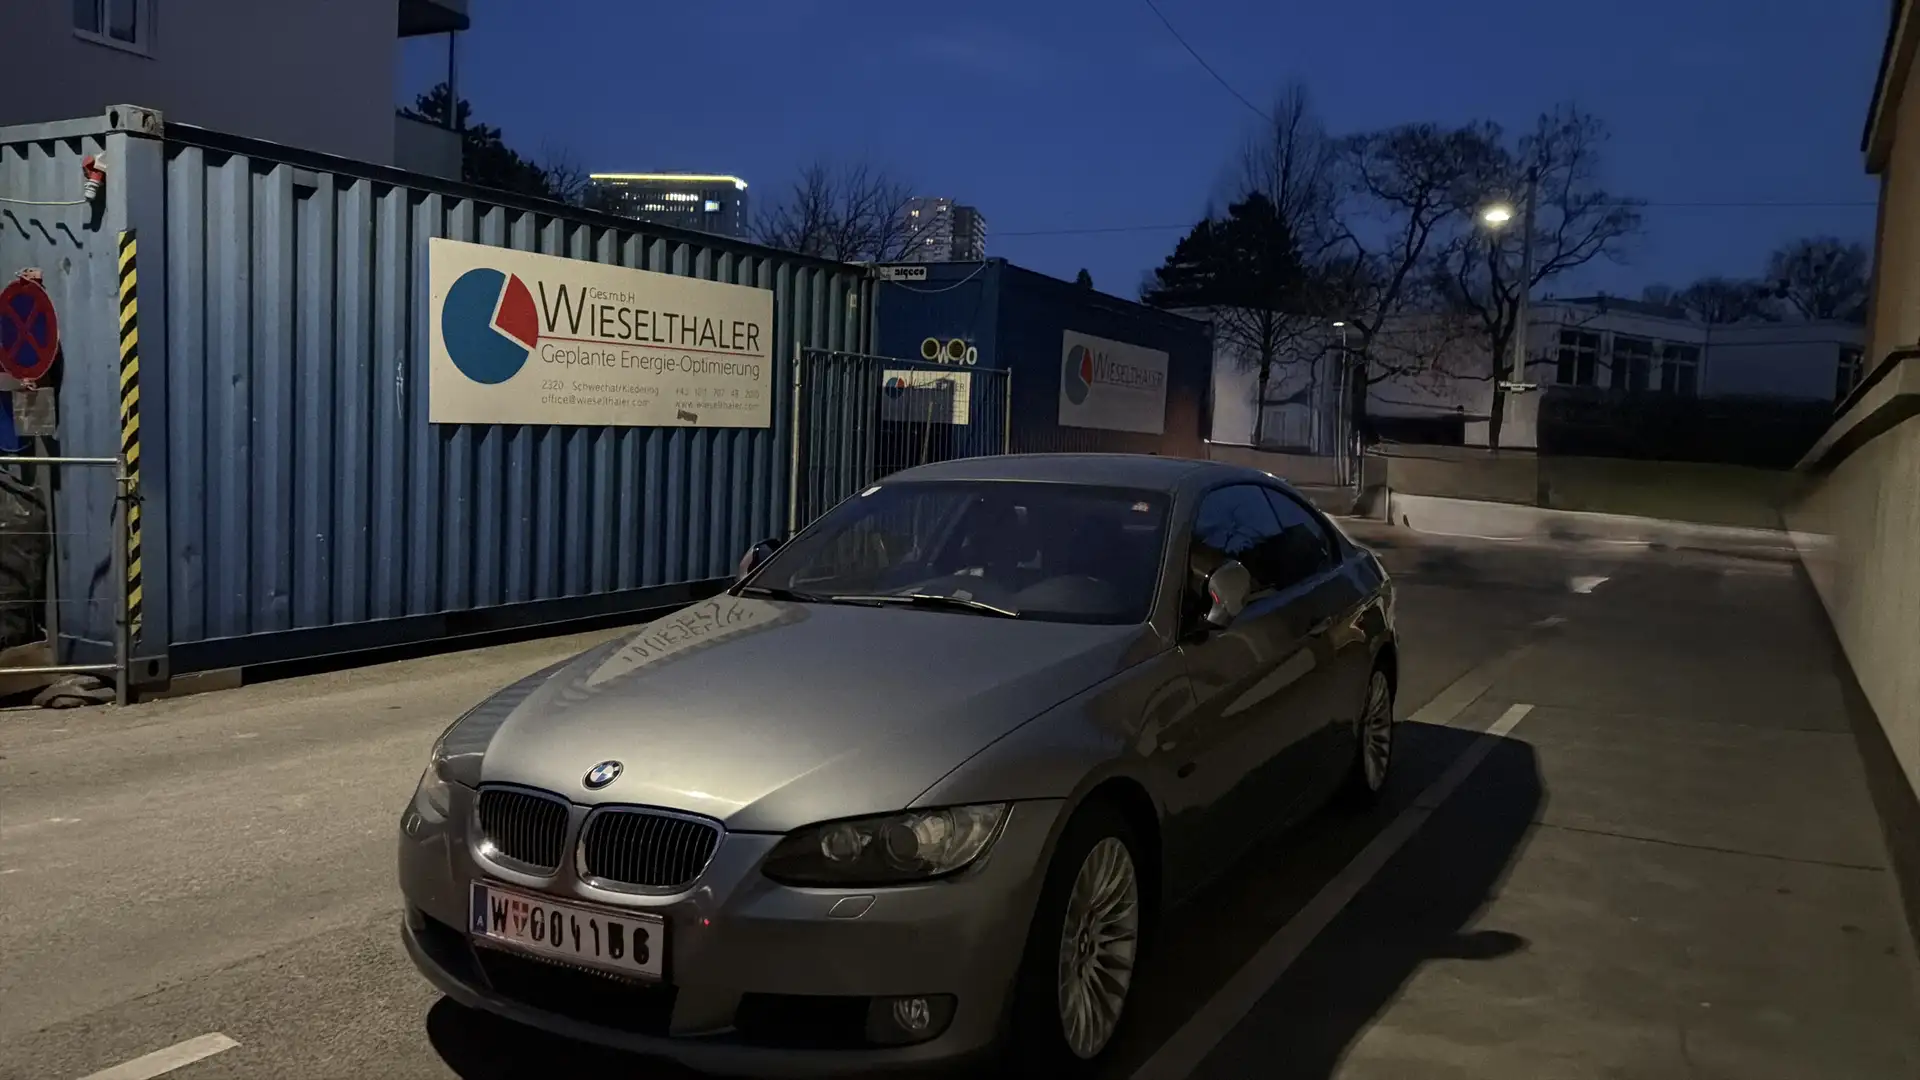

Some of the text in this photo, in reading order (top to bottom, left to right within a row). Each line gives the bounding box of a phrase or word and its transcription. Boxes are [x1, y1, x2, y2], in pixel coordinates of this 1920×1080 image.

[541, 344, 760, 380] Geplante Energie-Optimierung
[541, 380, 564, 390] 2320
[491, 896, 508, 934] W
